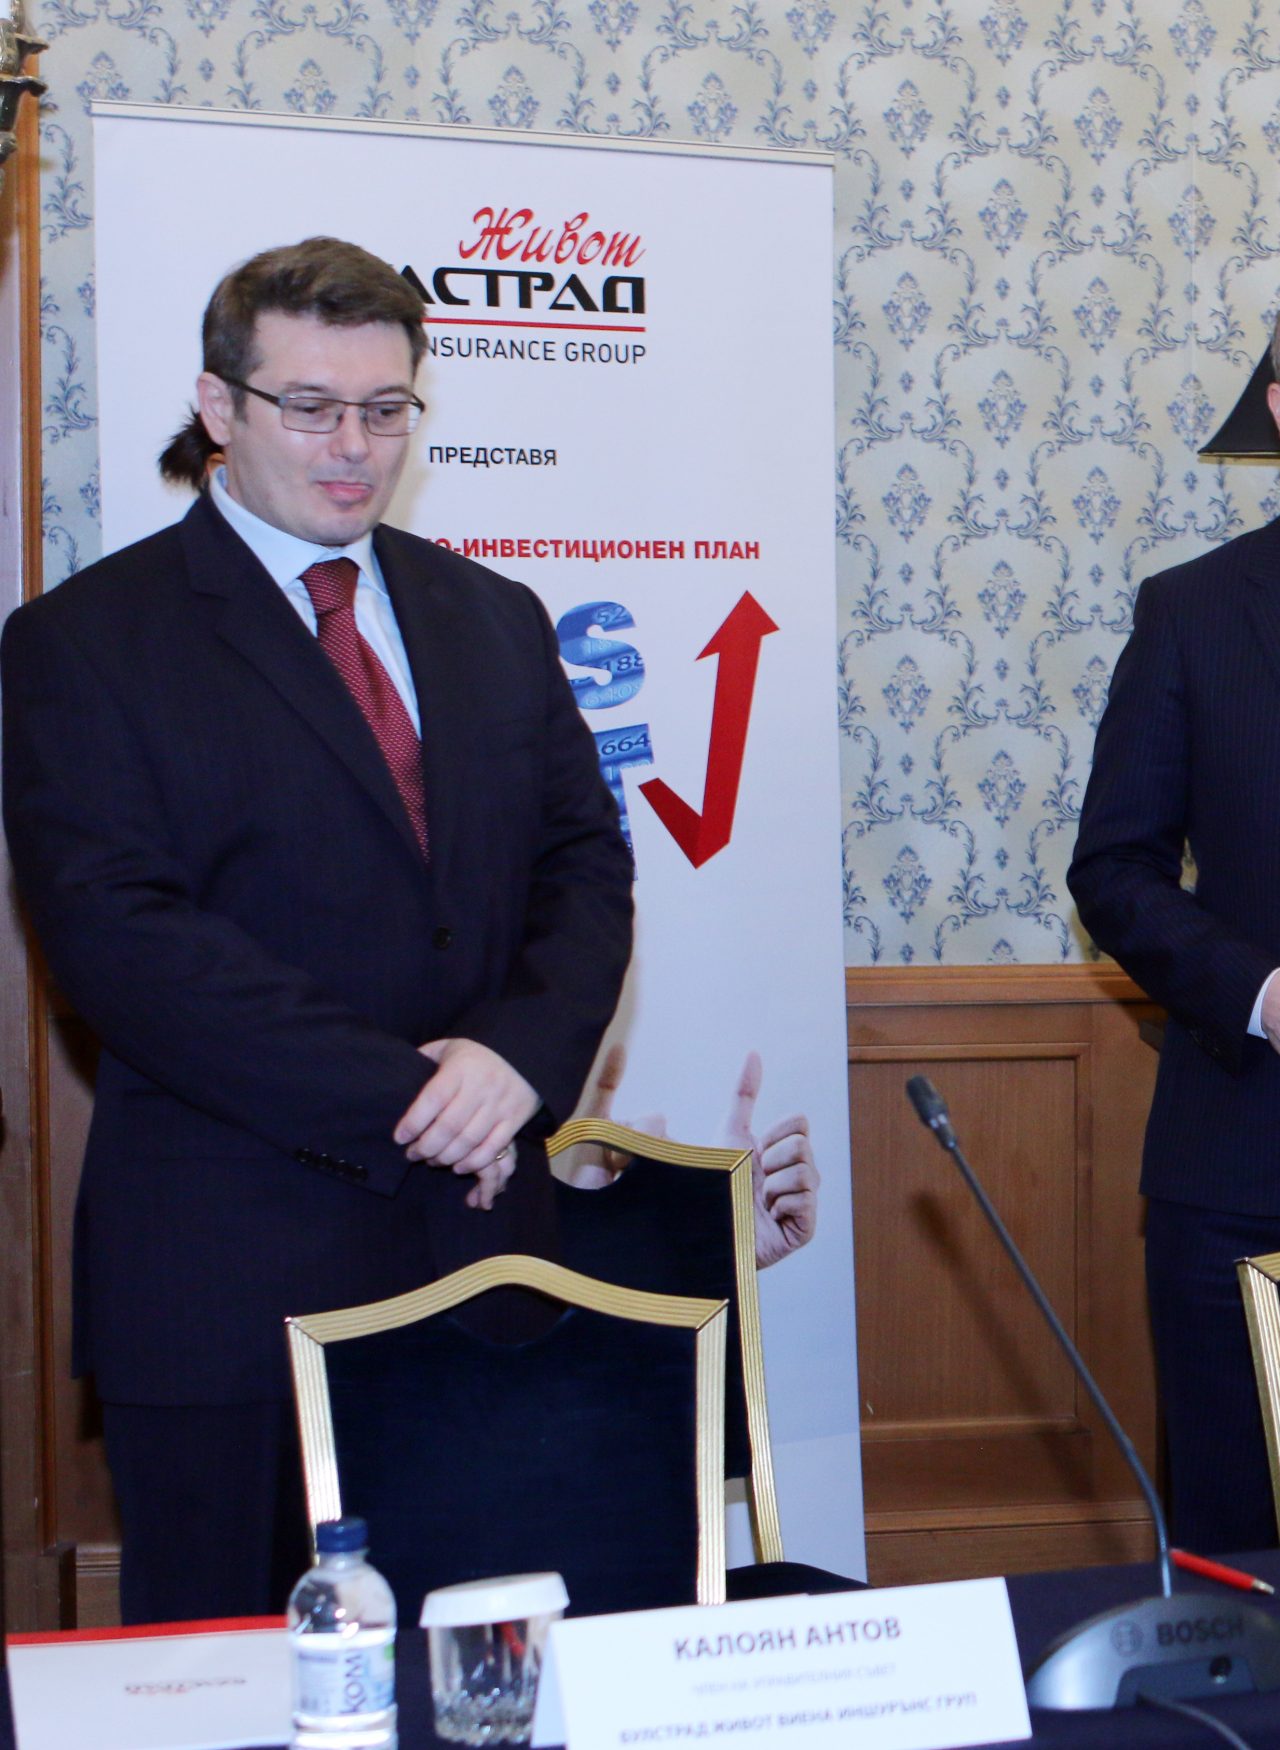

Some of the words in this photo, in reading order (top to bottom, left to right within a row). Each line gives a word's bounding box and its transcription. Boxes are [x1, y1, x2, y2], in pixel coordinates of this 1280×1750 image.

[458, 206, 646, 268] Живот
[564, 342, 646, 364] GROUP
[429, 446, 557, 468] ПРЕДСТАВЯ
[427, 537, 684, 563] -ИНВЕСТИЦИОНЕН
[694, 541, 760, 560] ПЛАН
[674, 1629, 797, 1661] КАЛОЯН
[806, 1617, 902, 1650] АНТОВ
[1156, 1617, 1245, 1647] BOSCH
